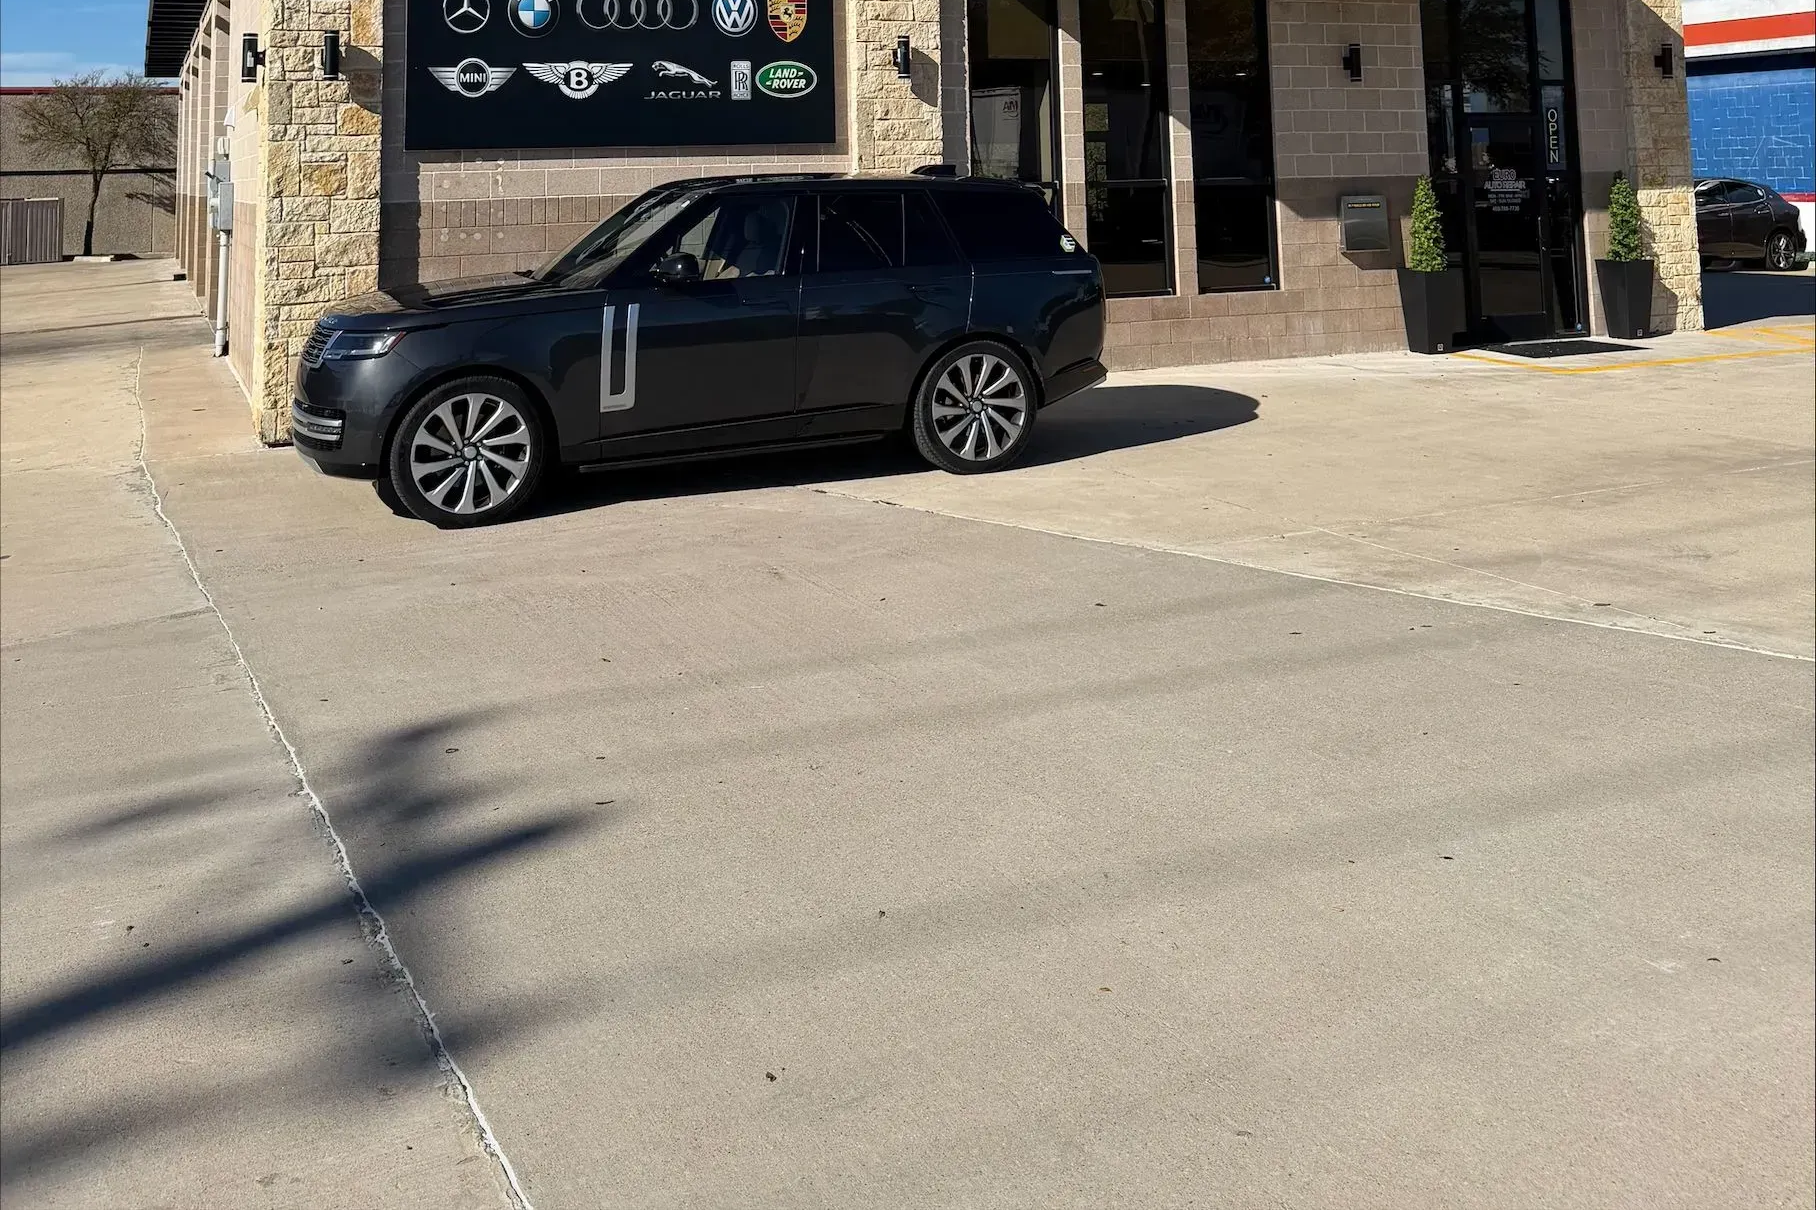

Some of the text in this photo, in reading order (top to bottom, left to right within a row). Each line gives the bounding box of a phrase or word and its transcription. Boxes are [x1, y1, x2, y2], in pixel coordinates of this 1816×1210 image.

[459, 72, 487, 83] MINI
[569, 68, 588, 89] B
[643, 90, 722, 100] JAGUAR
[1547, 108, 1559, 163] OPEN
[1492, 169, 1517, 181] EURO
[1483, 180, 1503, 189] AUTO
